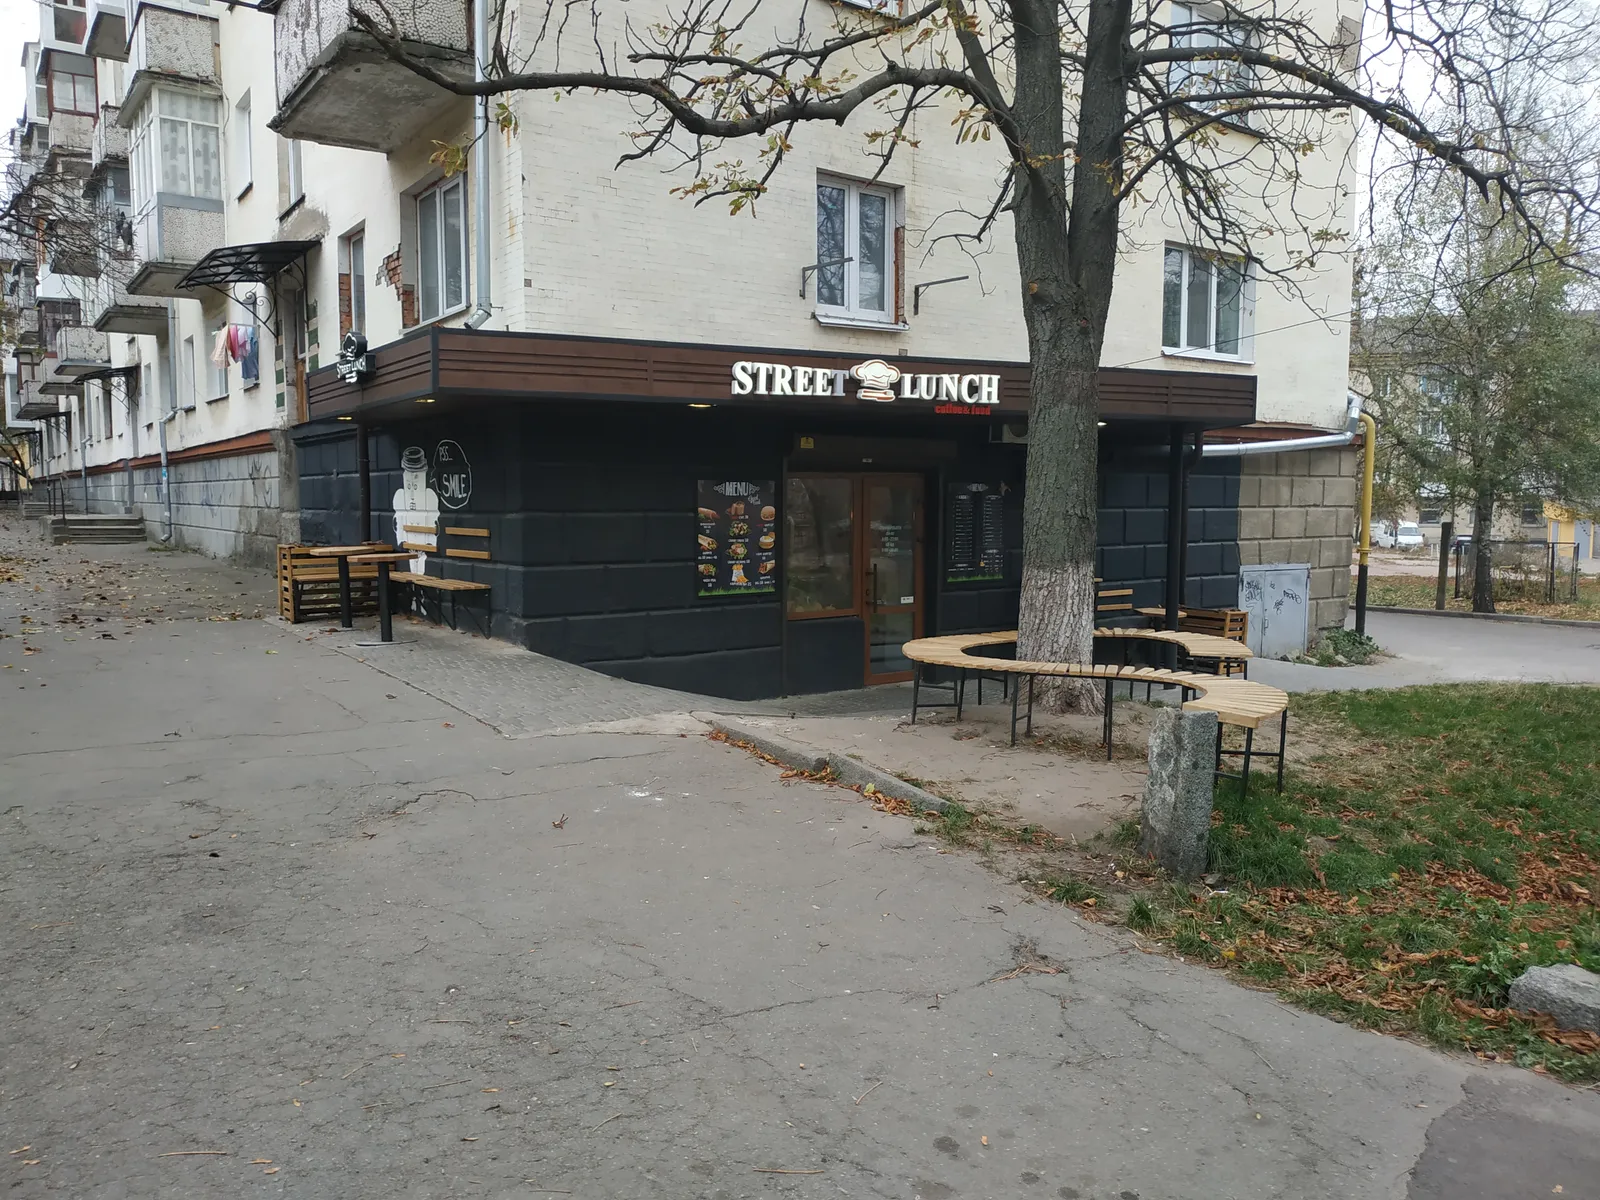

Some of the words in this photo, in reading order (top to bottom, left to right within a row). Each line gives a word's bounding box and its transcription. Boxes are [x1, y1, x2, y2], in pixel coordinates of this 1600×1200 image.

[336, 362, 351, 379] STREET
[731, 361, 850, 396] STREET
[898, 373, 1001, 403] LUNCH
[971, 404, 991, 416] food
[442, 474, 468, 498] SMILE
[725, 481, 749, 496] MENU
